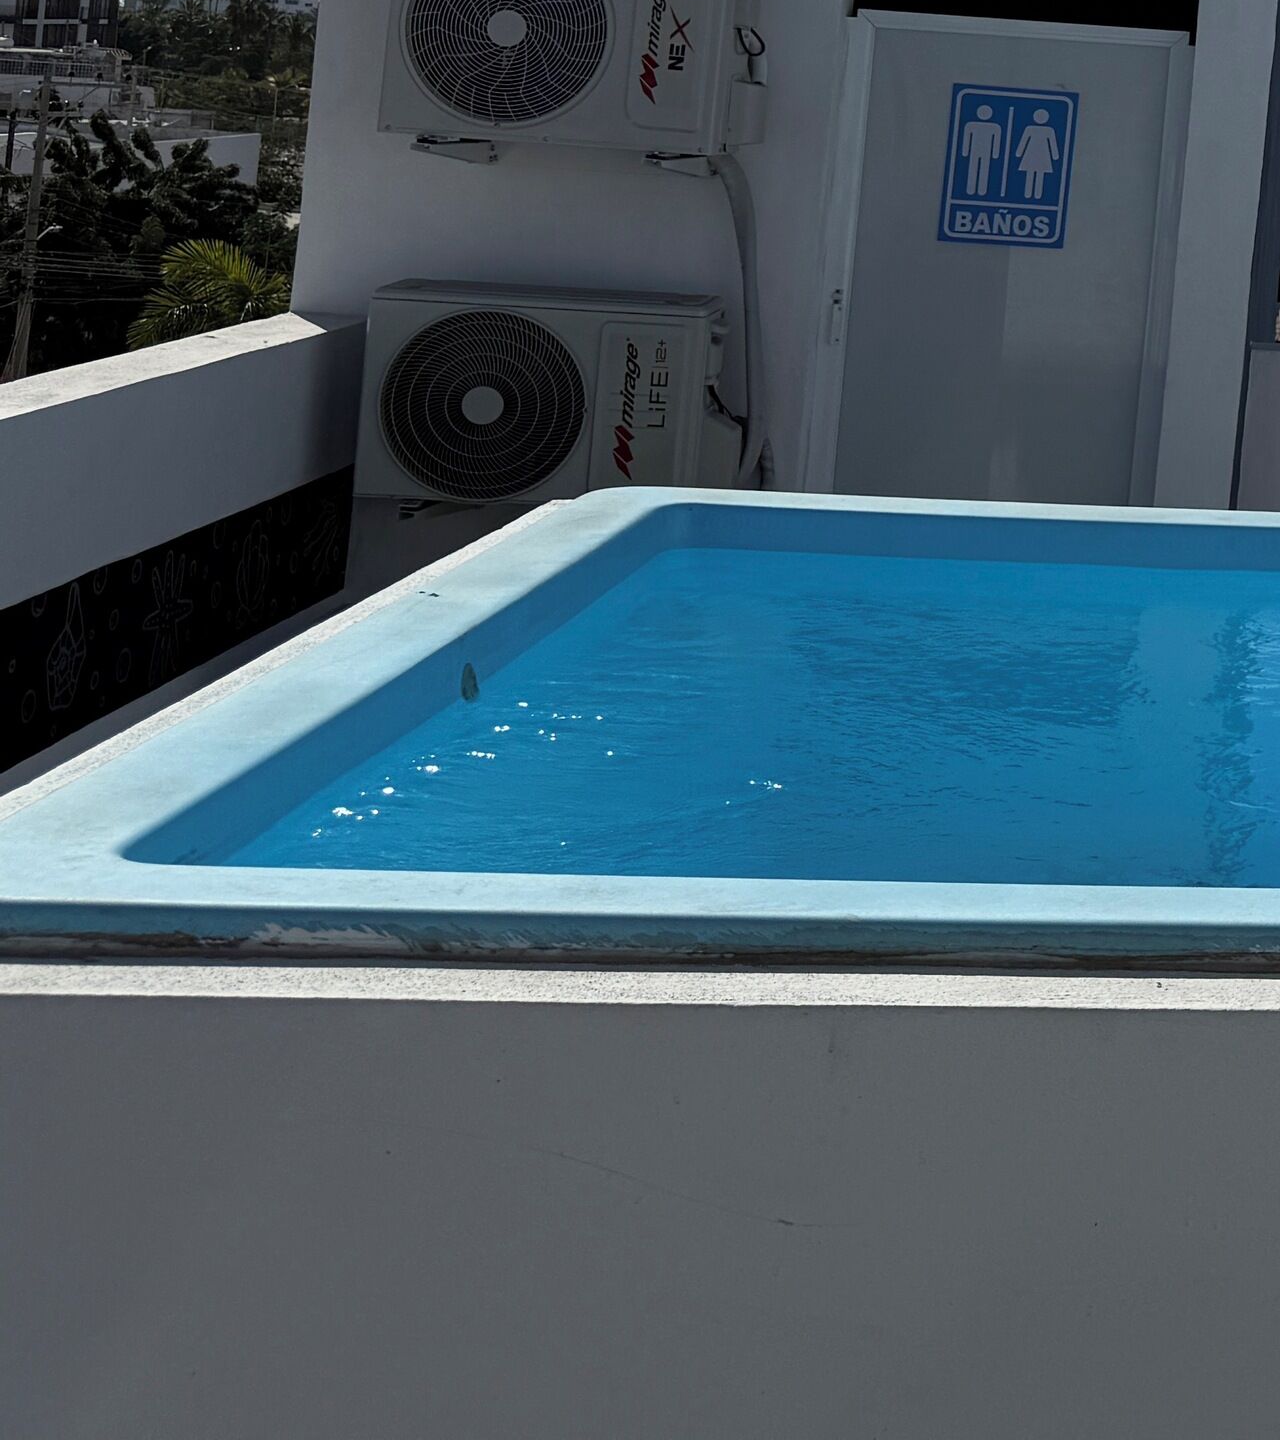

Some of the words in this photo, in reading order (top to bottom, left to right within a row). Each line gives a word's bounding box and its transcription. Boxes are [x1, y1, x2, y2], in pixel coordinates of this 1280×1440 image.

[668, 5, 694, 71] NEX
[955, 208, 1049, 238] BAÑOS
[620, 342, 640, 428] mirage
